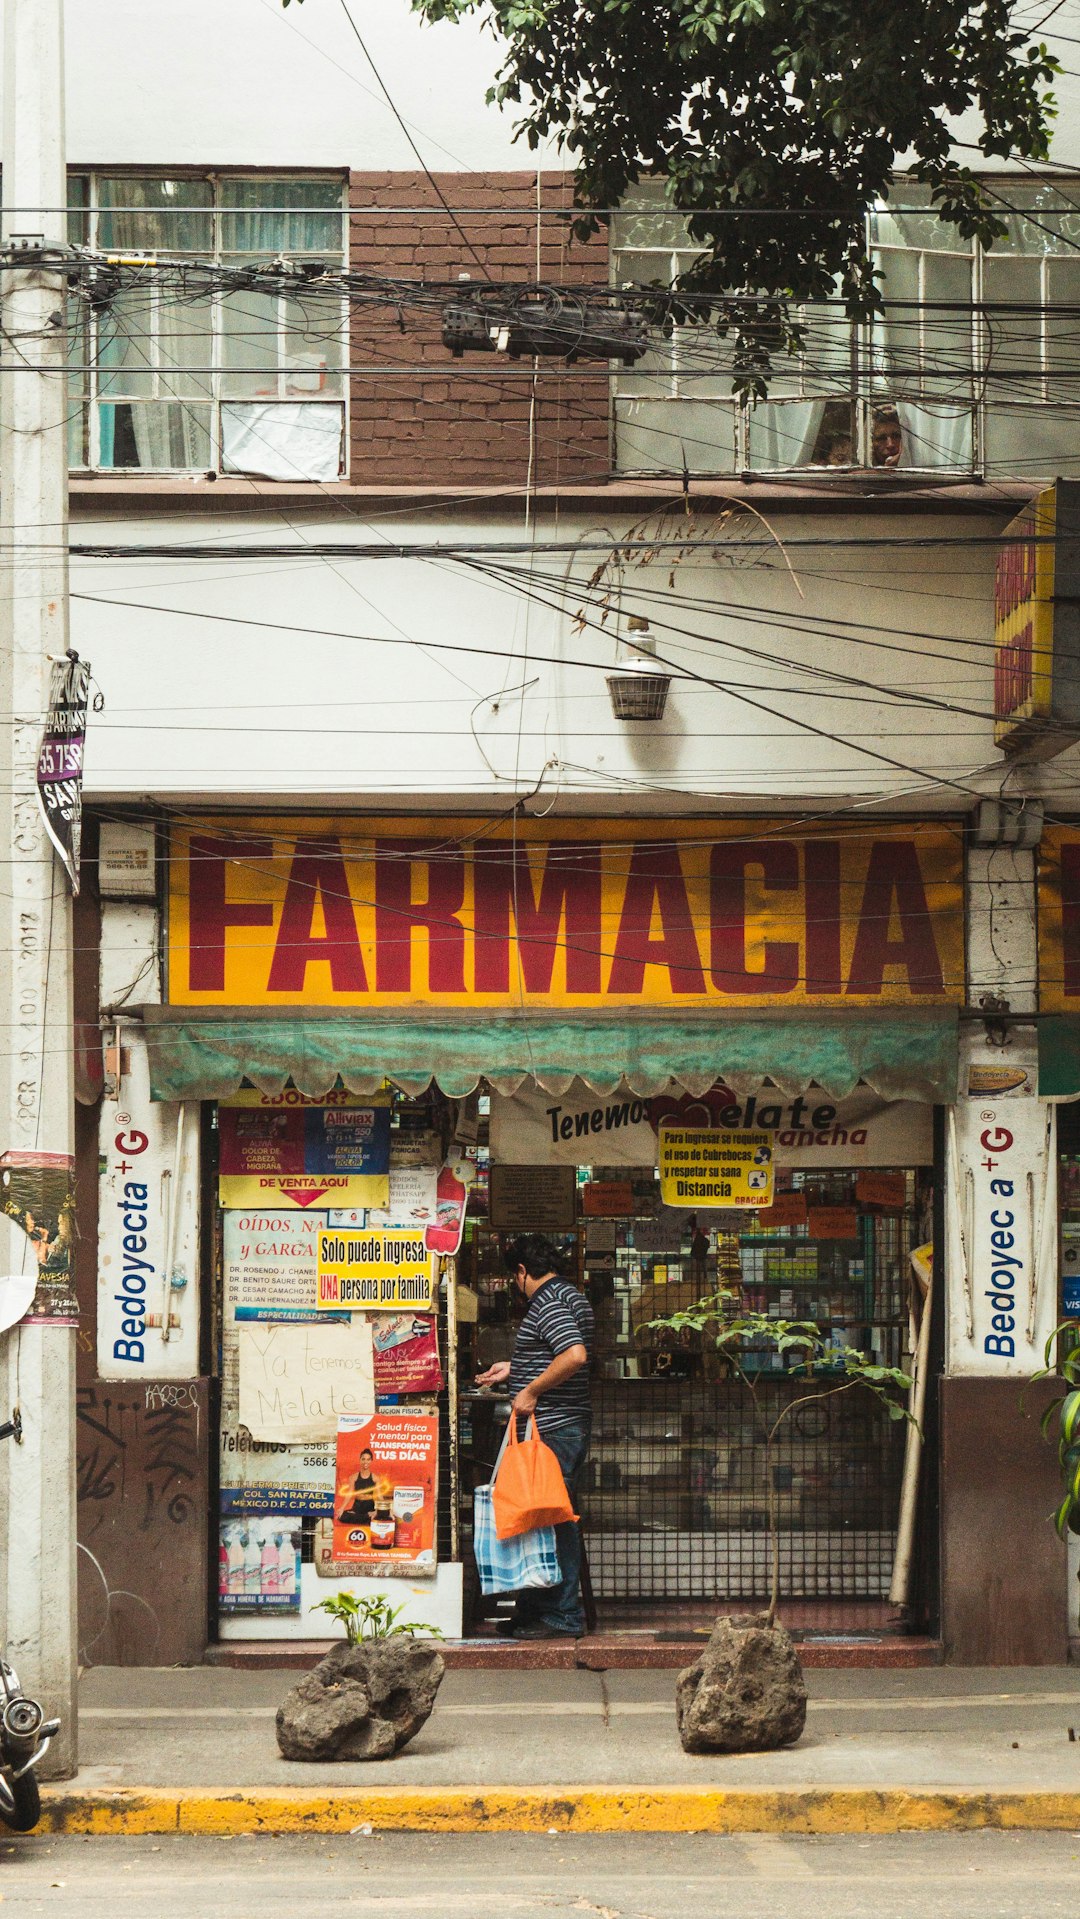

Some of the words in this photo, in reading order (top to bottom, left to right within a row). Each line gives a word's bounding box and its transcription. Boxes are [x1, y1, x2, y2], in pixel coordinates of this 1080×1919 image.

[188, 835, 947, 996] FARMACIA
[546, 1098, 652, 1142] Tenemos
[664, 1131, 684, 1144] Para
[721, 1134, 731, 1144] se
[733, 1133, 769, 1146] requiere
[241, 1147, 268, 1155] DOLOR
[269, 1147, 281, 1155] DE
[664, 1148, 672, 1161] el
[674, 1150, 689, 1161] uso
[690, 1149, 701, 1161] de
[702, 1148, 752, 1161] Cubrebocas
[246, 1161, 282, 1170] MIGRAÑA
[670, 1166, 708, 1179] respetar
[708, 1167, 720, 1178] su
[720, 1167, 742, 1178] sana
[259, 1179, 275, 1187] DE
[278, 1178, 317, 1187] VENTA
[319, 1176, 349, 1187] AQUÍ
[676, 1180, 732, 1197] Distancia
[734, 1196, 769, 1205] GRACIAS
[238, 1213, 295, 1234] OÍDOS,
[239, 1243, 251, 1261] y
[255, 1241, 318, 1258] GARGA
[321, 1236, 345, 1263] Solo
[347, 1236, 381, 1265] puede
[113, 1180, 155, 1364] Bedoyecta
[243, 1266, 280, 1275] ROSENDO
[243, 1276, 270, 1284] BENITO
[271, 1277, 296, 1285] SAURE
[268, 1287, 304, 1295] CAMACHO
[320, 1274, 338, 1300] UNA
[340, 1277, 378, 1303] persona
[380, 1277, 396, 1303] por
[397, 1274, 430, 1300] familia
[257, 1310, 329, 1321] ESPECIALIDADES
[248, 1329, 289, 1381] Ya
[302, 1331, 362, 1376] tenemos
[257, 1384, 359, 1425] Melate
[376, 1422, 402, 1431] Salud
[403, 1423, 428, 1432] física
[377, 1432, 410, 1440] mental
[410, 1434, 433, 1442] para
[369, 1441, 431, 1450] TRANSFORMAR
[374, 1450, 397, 1460] TUS
[398, 1450, 427, 1461] DÍAS
[303, 1457, 328, 1467] 5566
[225, 1480, 280, 1489] GUILLERMO
[281, 1481, 317, 1490] PRIETO
[318, 1482, 335, 1490] No.
[243, 1490, 266, 1498] COL.
[267, 1491, 288, 1499] SAN
[289, 1491, 328, 1500] RAFAEL
[270, 1500, 288, 1508] D.F.
[289, 1501, 307, 1509] C.P.
[350, 1531, 365, 1541] 60
[223, 1595, 237, 1603] AGUA
[257, 1595, 265, 1603] DE
